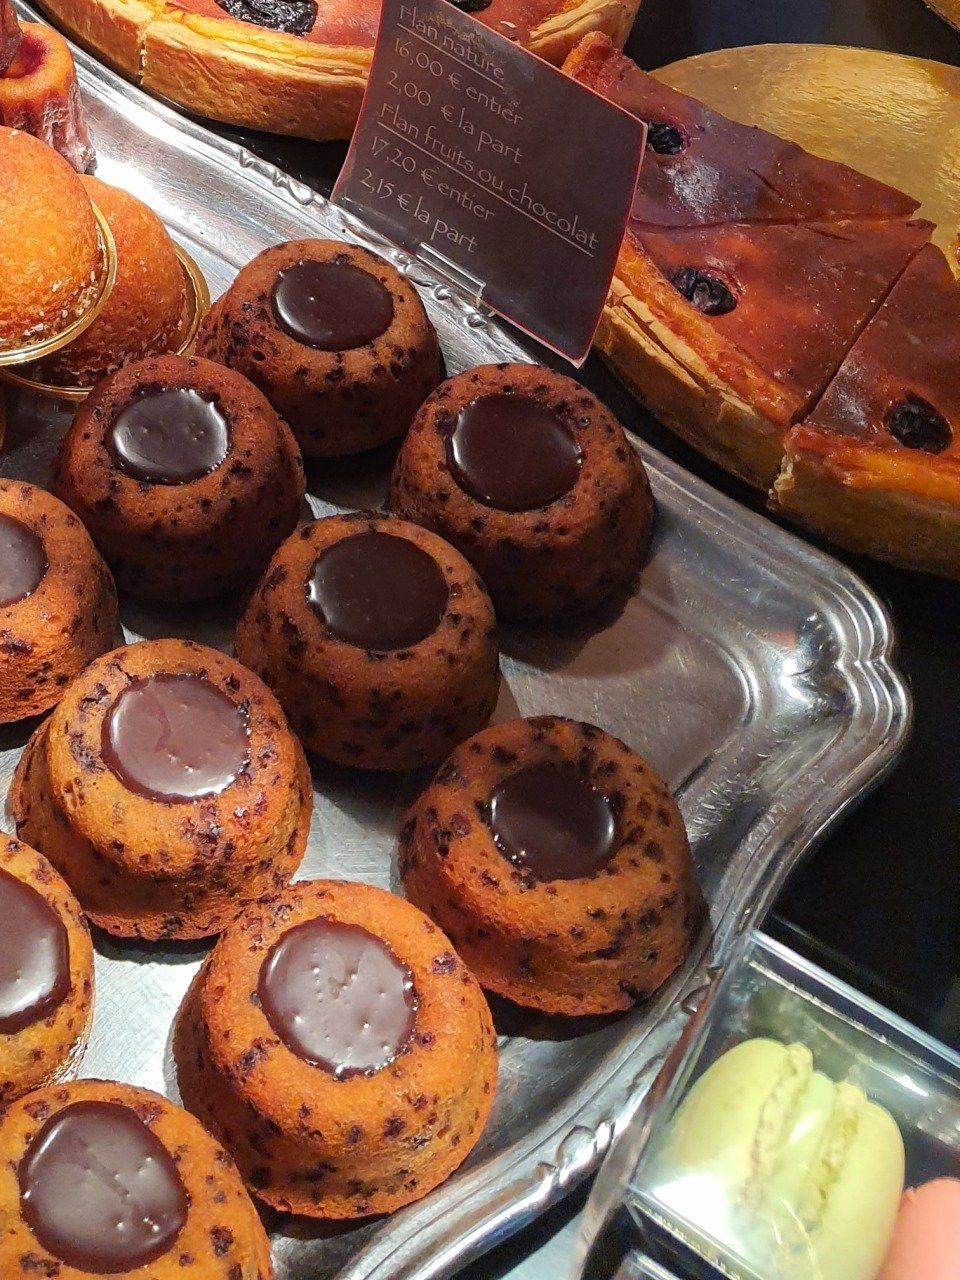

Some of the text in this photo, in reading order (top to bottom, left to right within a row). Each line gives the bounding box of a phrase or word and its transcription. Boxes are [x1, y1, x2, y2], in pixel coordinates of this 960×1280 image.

[394, 37, 524, 125] 16,00 € entier
[399, 4, 505, 81] Flan nature
[386, 70, 525, 166] 2,00 € la part
[359, 167, 395, 200] 2,15
[413, 195, 431, 225] la
[430, 219, 479, 254] part
[370, 135, 417, 173] 17,20
[438, 180, 495, 221] entier
[380, 102, 601, 250] Flan fruits ou chocolat
